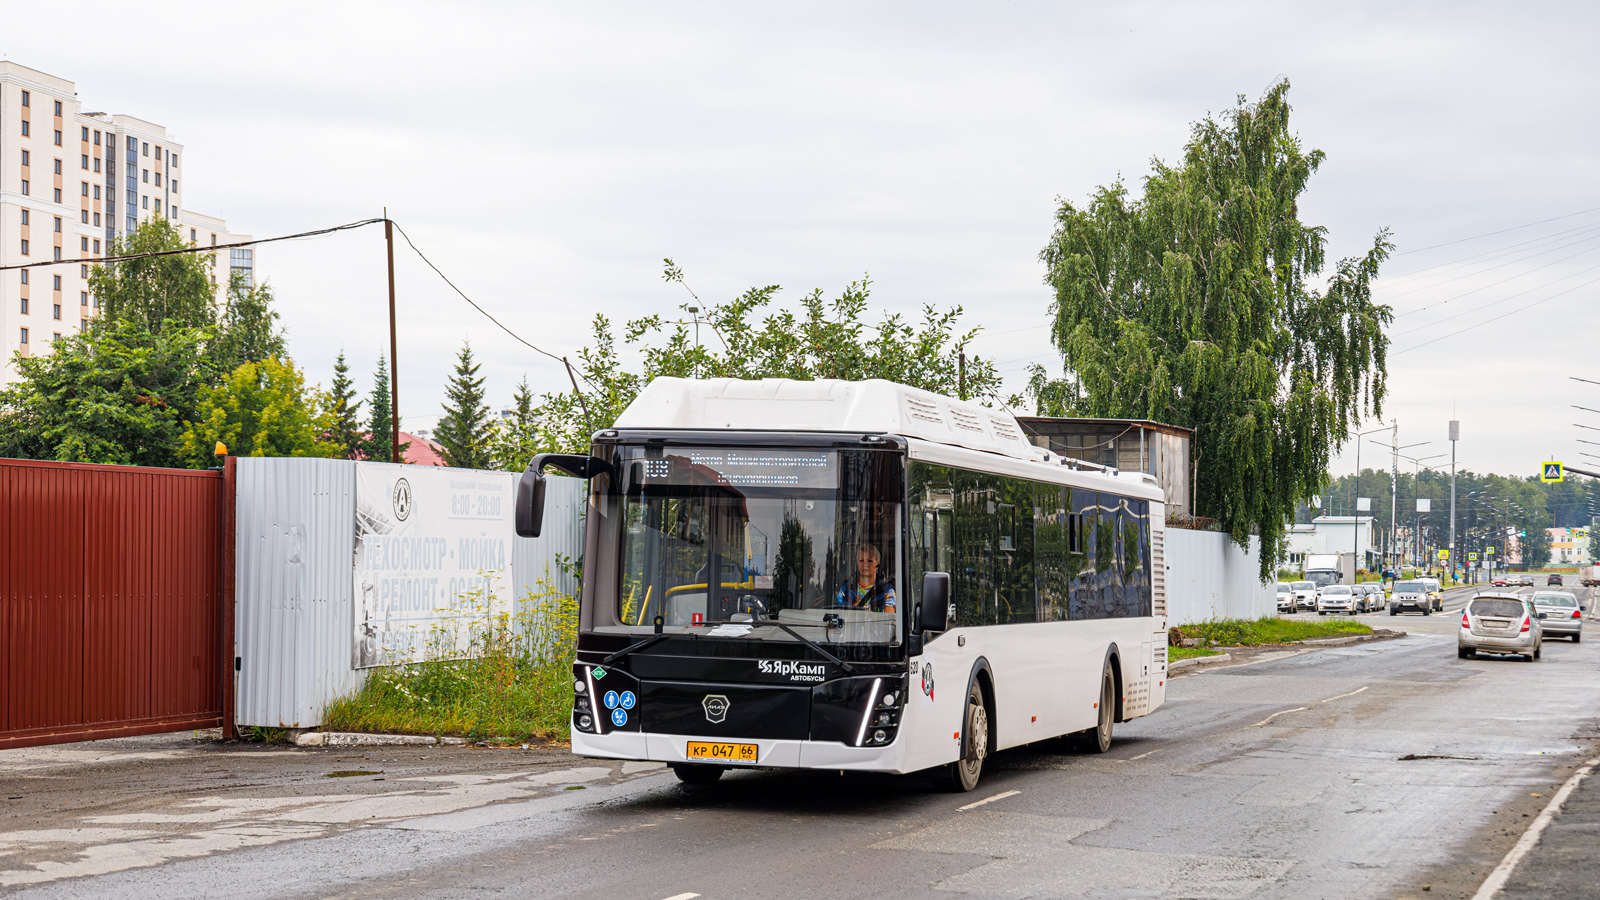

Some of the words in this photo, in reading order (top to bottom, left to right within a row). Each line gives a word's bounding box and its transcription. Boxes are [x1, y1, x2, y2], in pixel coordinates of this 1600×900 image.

[452, 494, 470, 515] 8:00
[477, 495, 501, 516] 20:00
[363, 535, 447, 570] ТЕХОСМОТР
[458, 531, 506, 570] МОЙКА
[380, 577, 438, 612] РЕМОНТ
[773, 660, 825, 676] ЯрКамп
[712, 744, 734, 757] 047
[741, 745, 753, 755] 66
